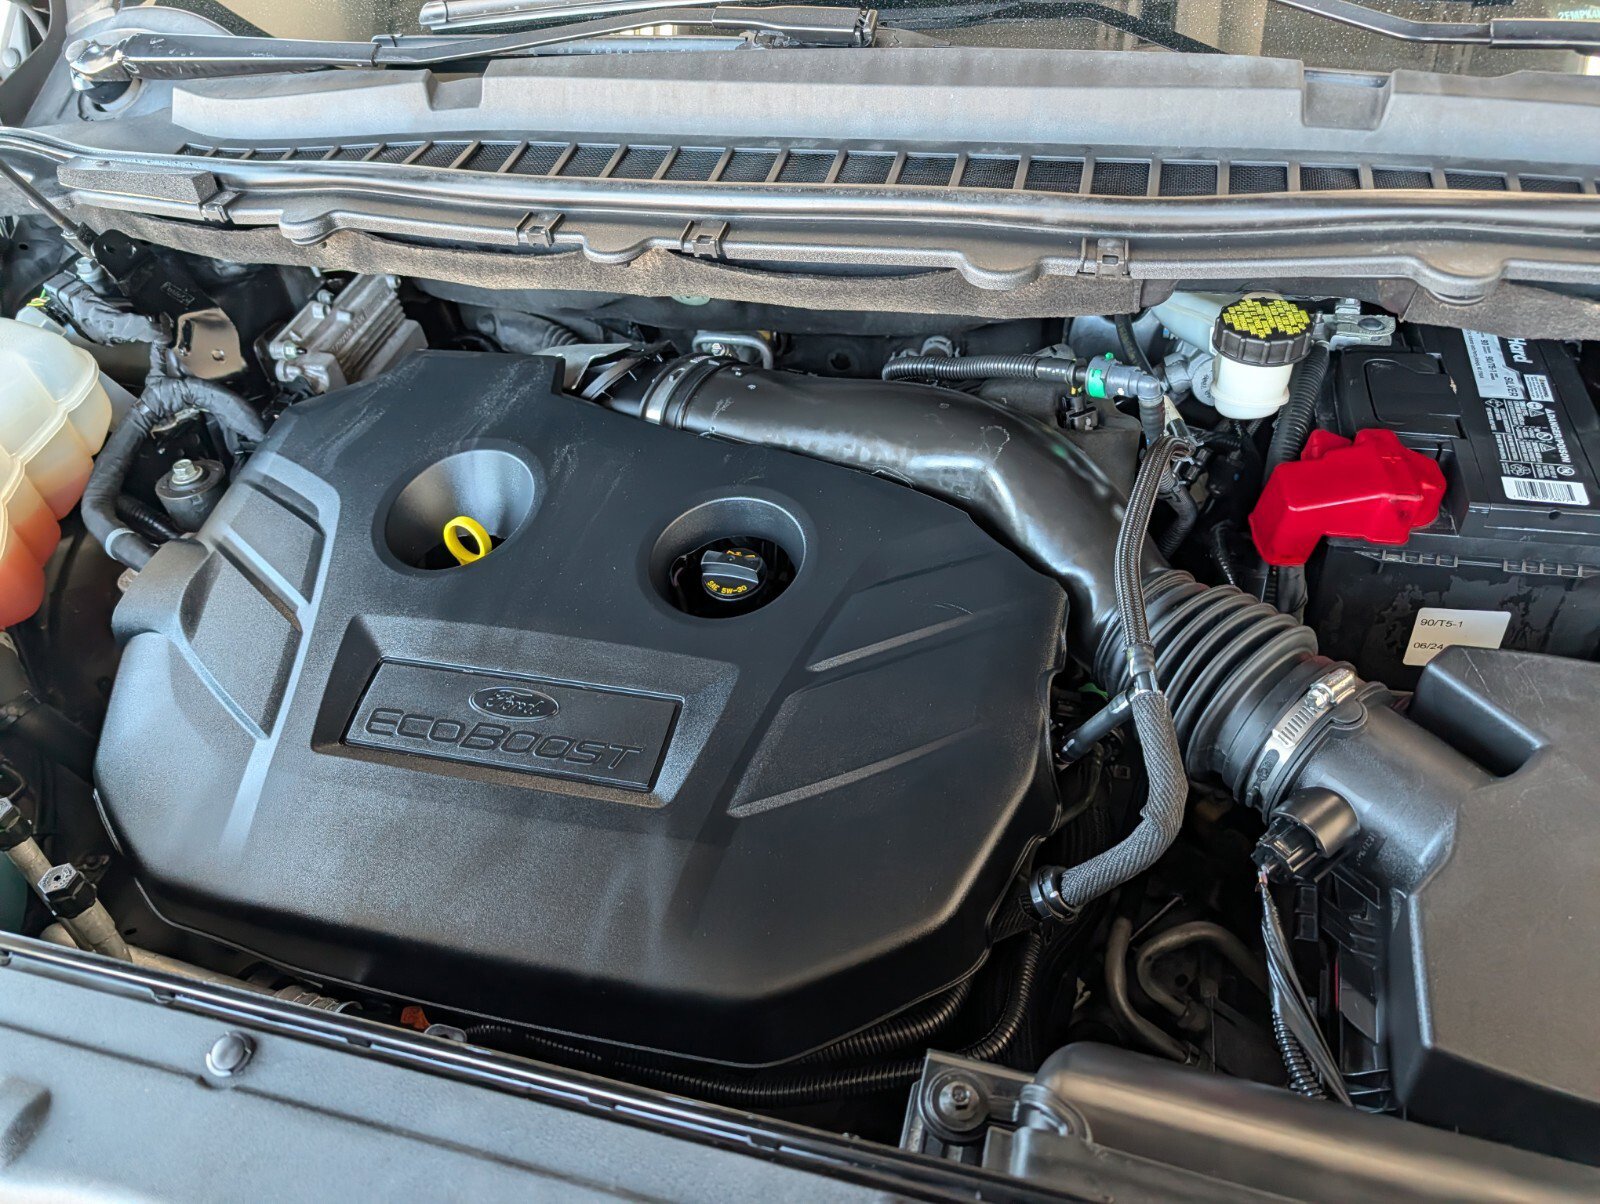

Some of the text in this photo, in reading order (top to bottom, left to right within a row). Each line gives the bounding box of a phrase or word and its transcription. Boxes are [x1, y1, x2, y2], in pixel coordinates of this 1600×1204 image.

[1503, 376, 1519, 397] SILVER
[706, 580, 748, 594] SAE 5W-30
[1420, 618, 1463, 628] 90/T5-1
[1413, 642, 1444, 650] 06/24
[485, 688, 546, 717] Ford
[364, 706, 645, 770] ECOBOOST
